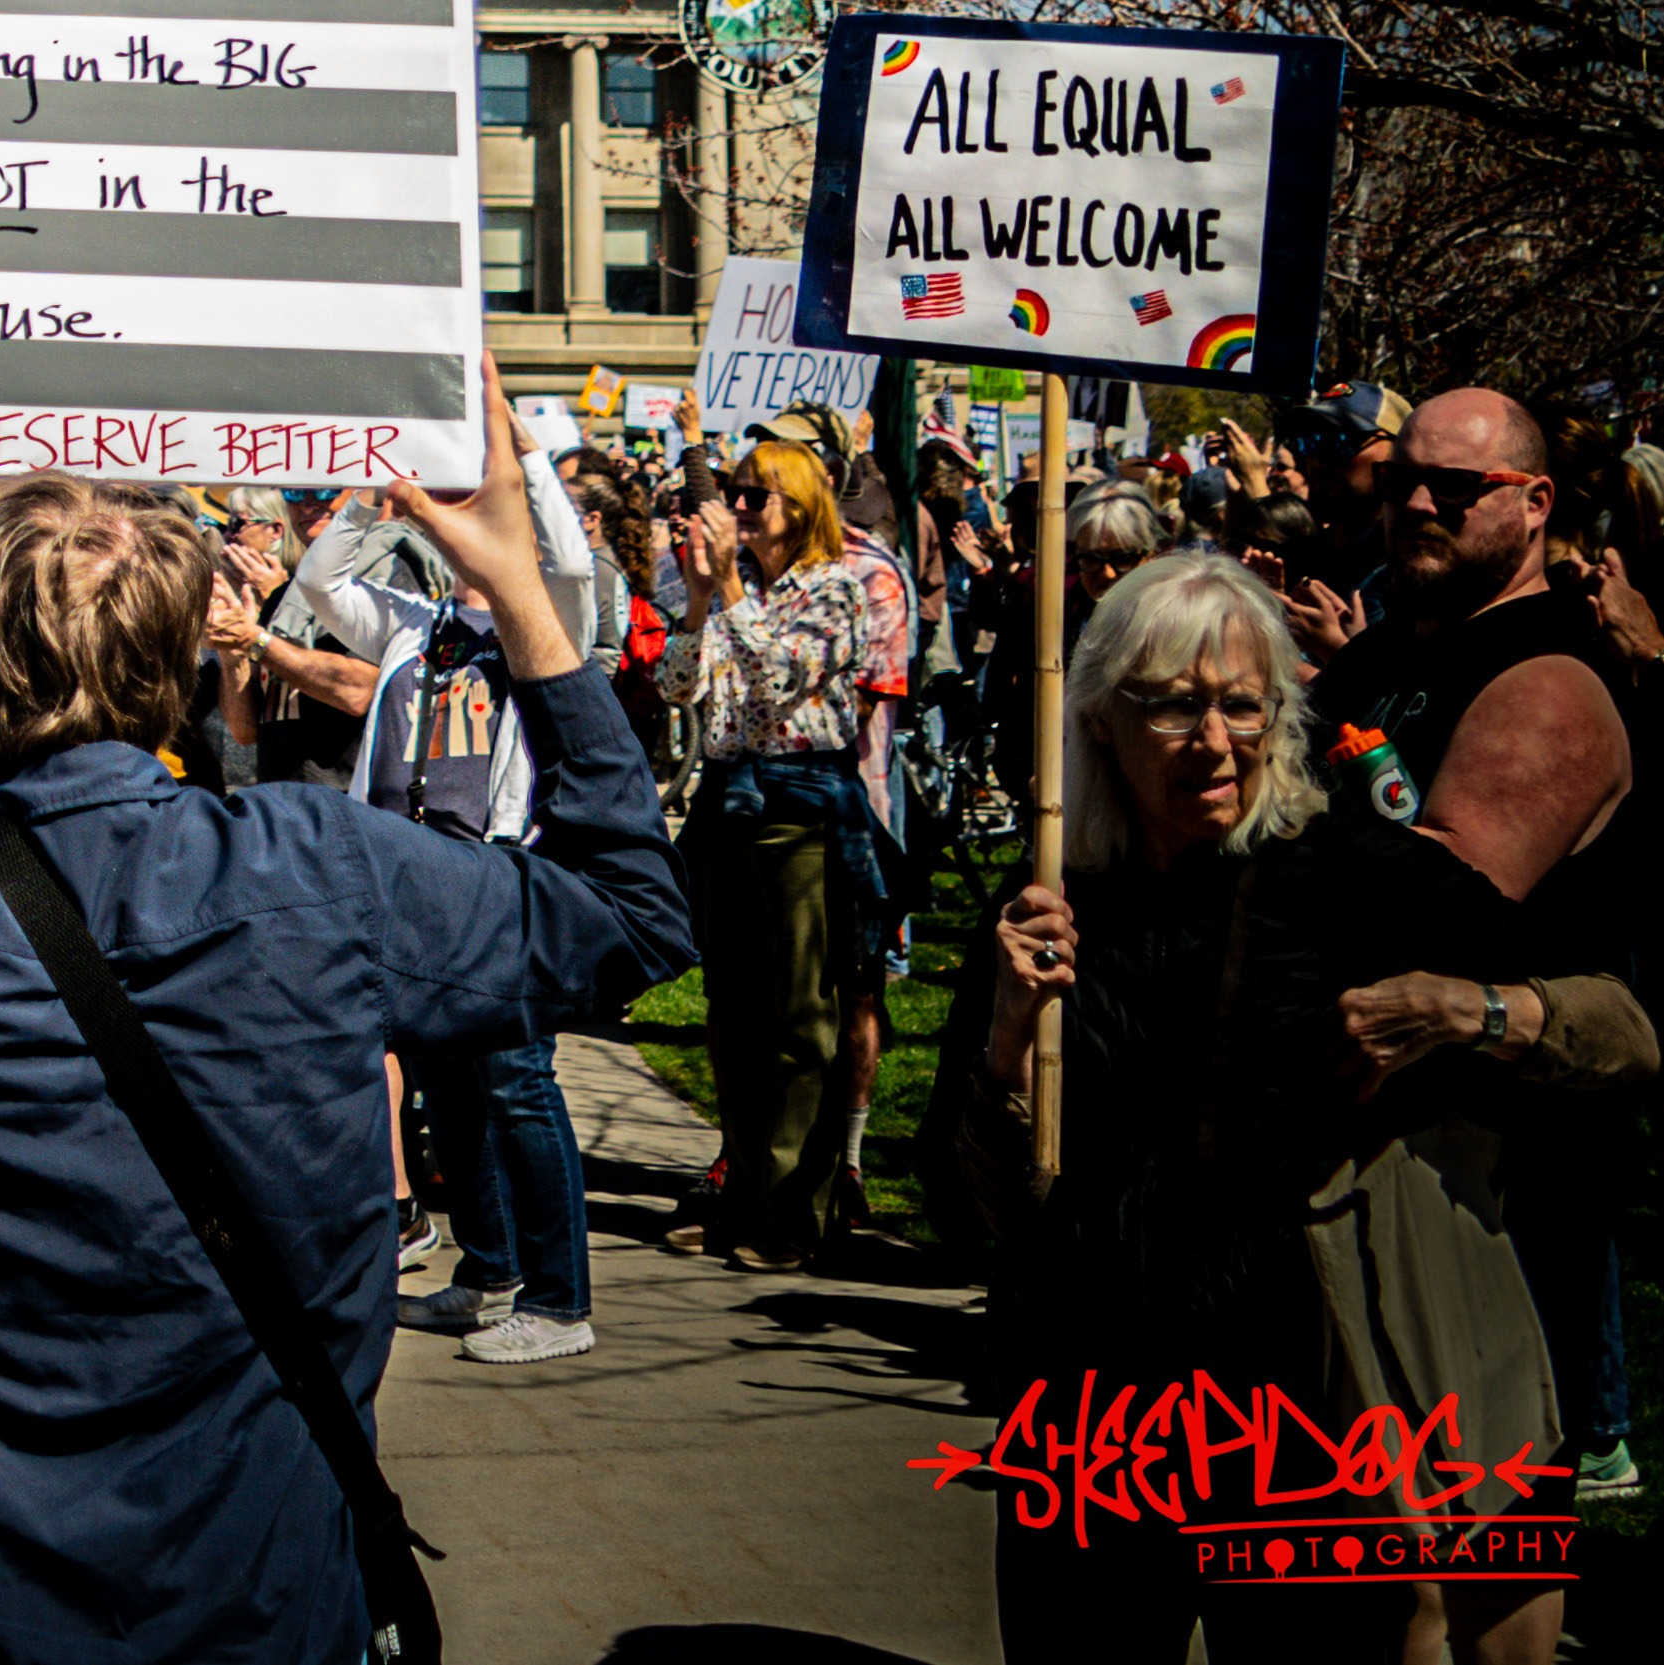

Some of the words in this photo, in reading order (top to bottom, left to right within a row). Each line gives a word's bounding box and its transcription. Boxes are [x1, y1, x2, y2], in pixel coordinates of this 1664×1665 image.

[54, 39, 101, 82] in
[116, 35, 199, 87] the
[214, 37, 317, 90] BIG
[904, 67, 1008, 154] ALL
[1032, 69, 1212, 163] EQUAL
[98, 158, 147, 210] in
[181, 157, 288, 218] the
[886, 193, 969, 261] ALL
[979, 195, 1226, 275] WELCOME
[706, 351, 875, 410] VETERANS
[215, 420, 424, 483] BETTER.
